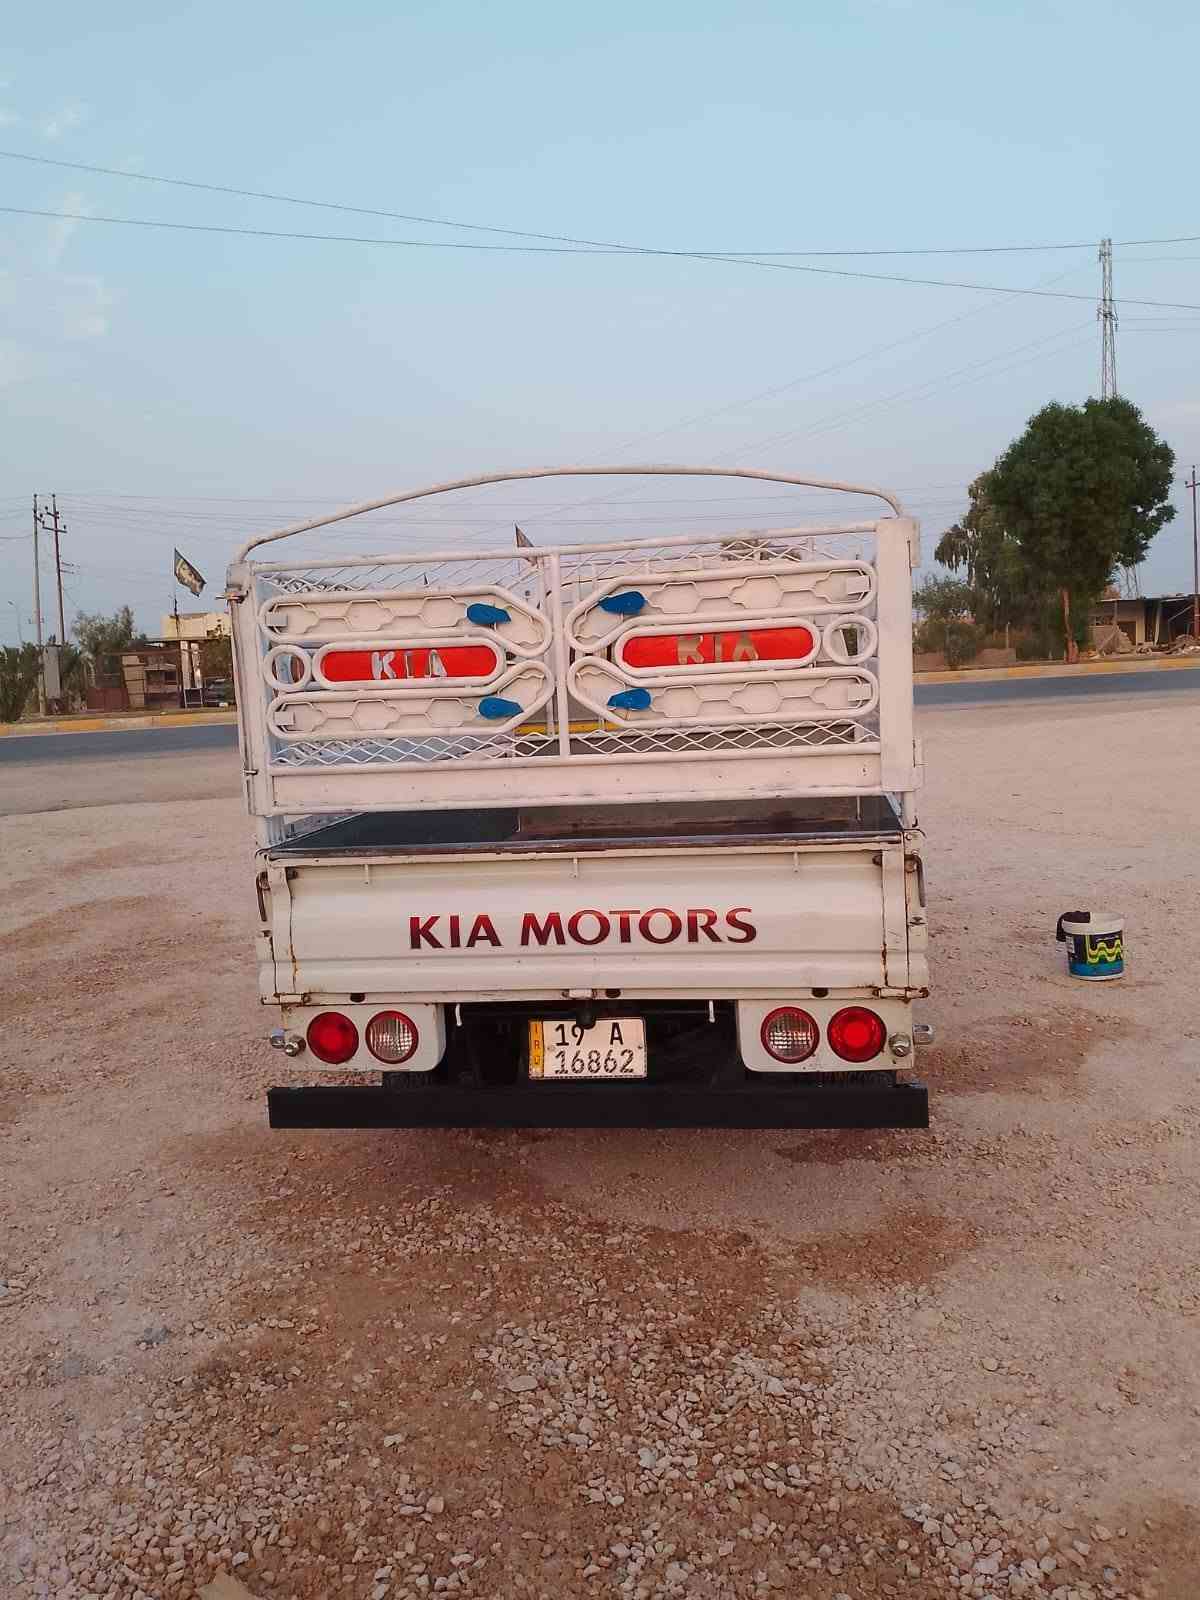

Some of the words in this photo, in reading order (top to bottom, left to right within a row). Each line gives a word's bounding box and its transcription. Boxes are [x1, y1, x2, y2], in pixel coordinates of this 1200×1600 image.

[371, 648, 448, 681] KIA
[676, 632, 760, 665] KIA
[409, 914, 503, 949] KIA
[520, 907, 757, 946] MOTORS
[555, 1024, 585, 1046] 19
[610, 1022, 624, 1045] A
[555, 1049, 634, 1074] 16862
